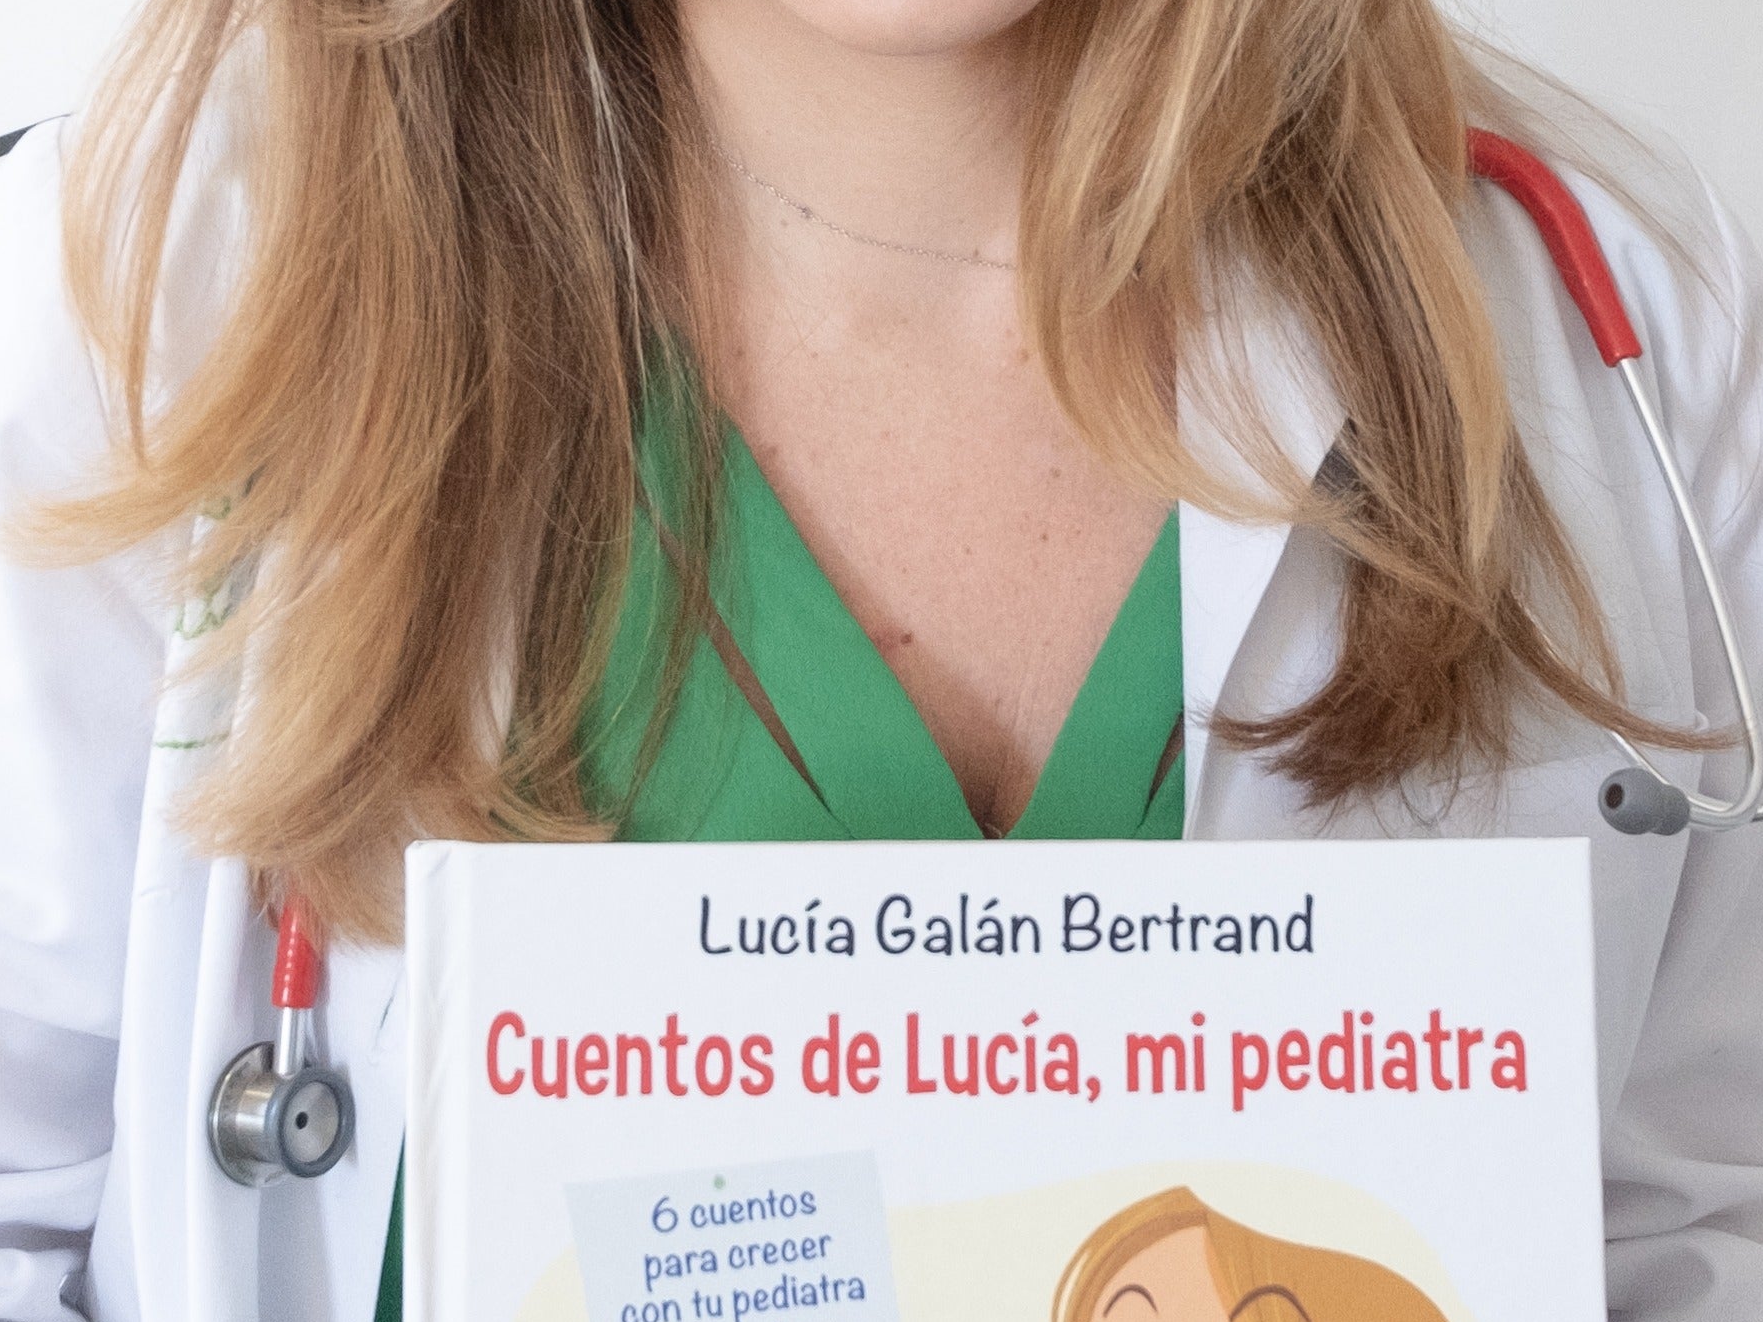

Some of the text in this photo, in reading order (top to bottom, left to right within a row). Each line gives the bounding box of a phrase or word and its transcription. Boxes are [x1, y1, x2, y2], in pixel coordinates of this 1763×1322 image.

[699, 892, 1314, 957] Lucía Galán Bertrand
[486, 1008, 1528, 1113] Cuentos de Lucía, mi pediatra
[651, 1189, 817, 1234] 6 cuentos
[644, 1234, 832, 1292] para crecer
[693, 1289, 723, 1319] tu
